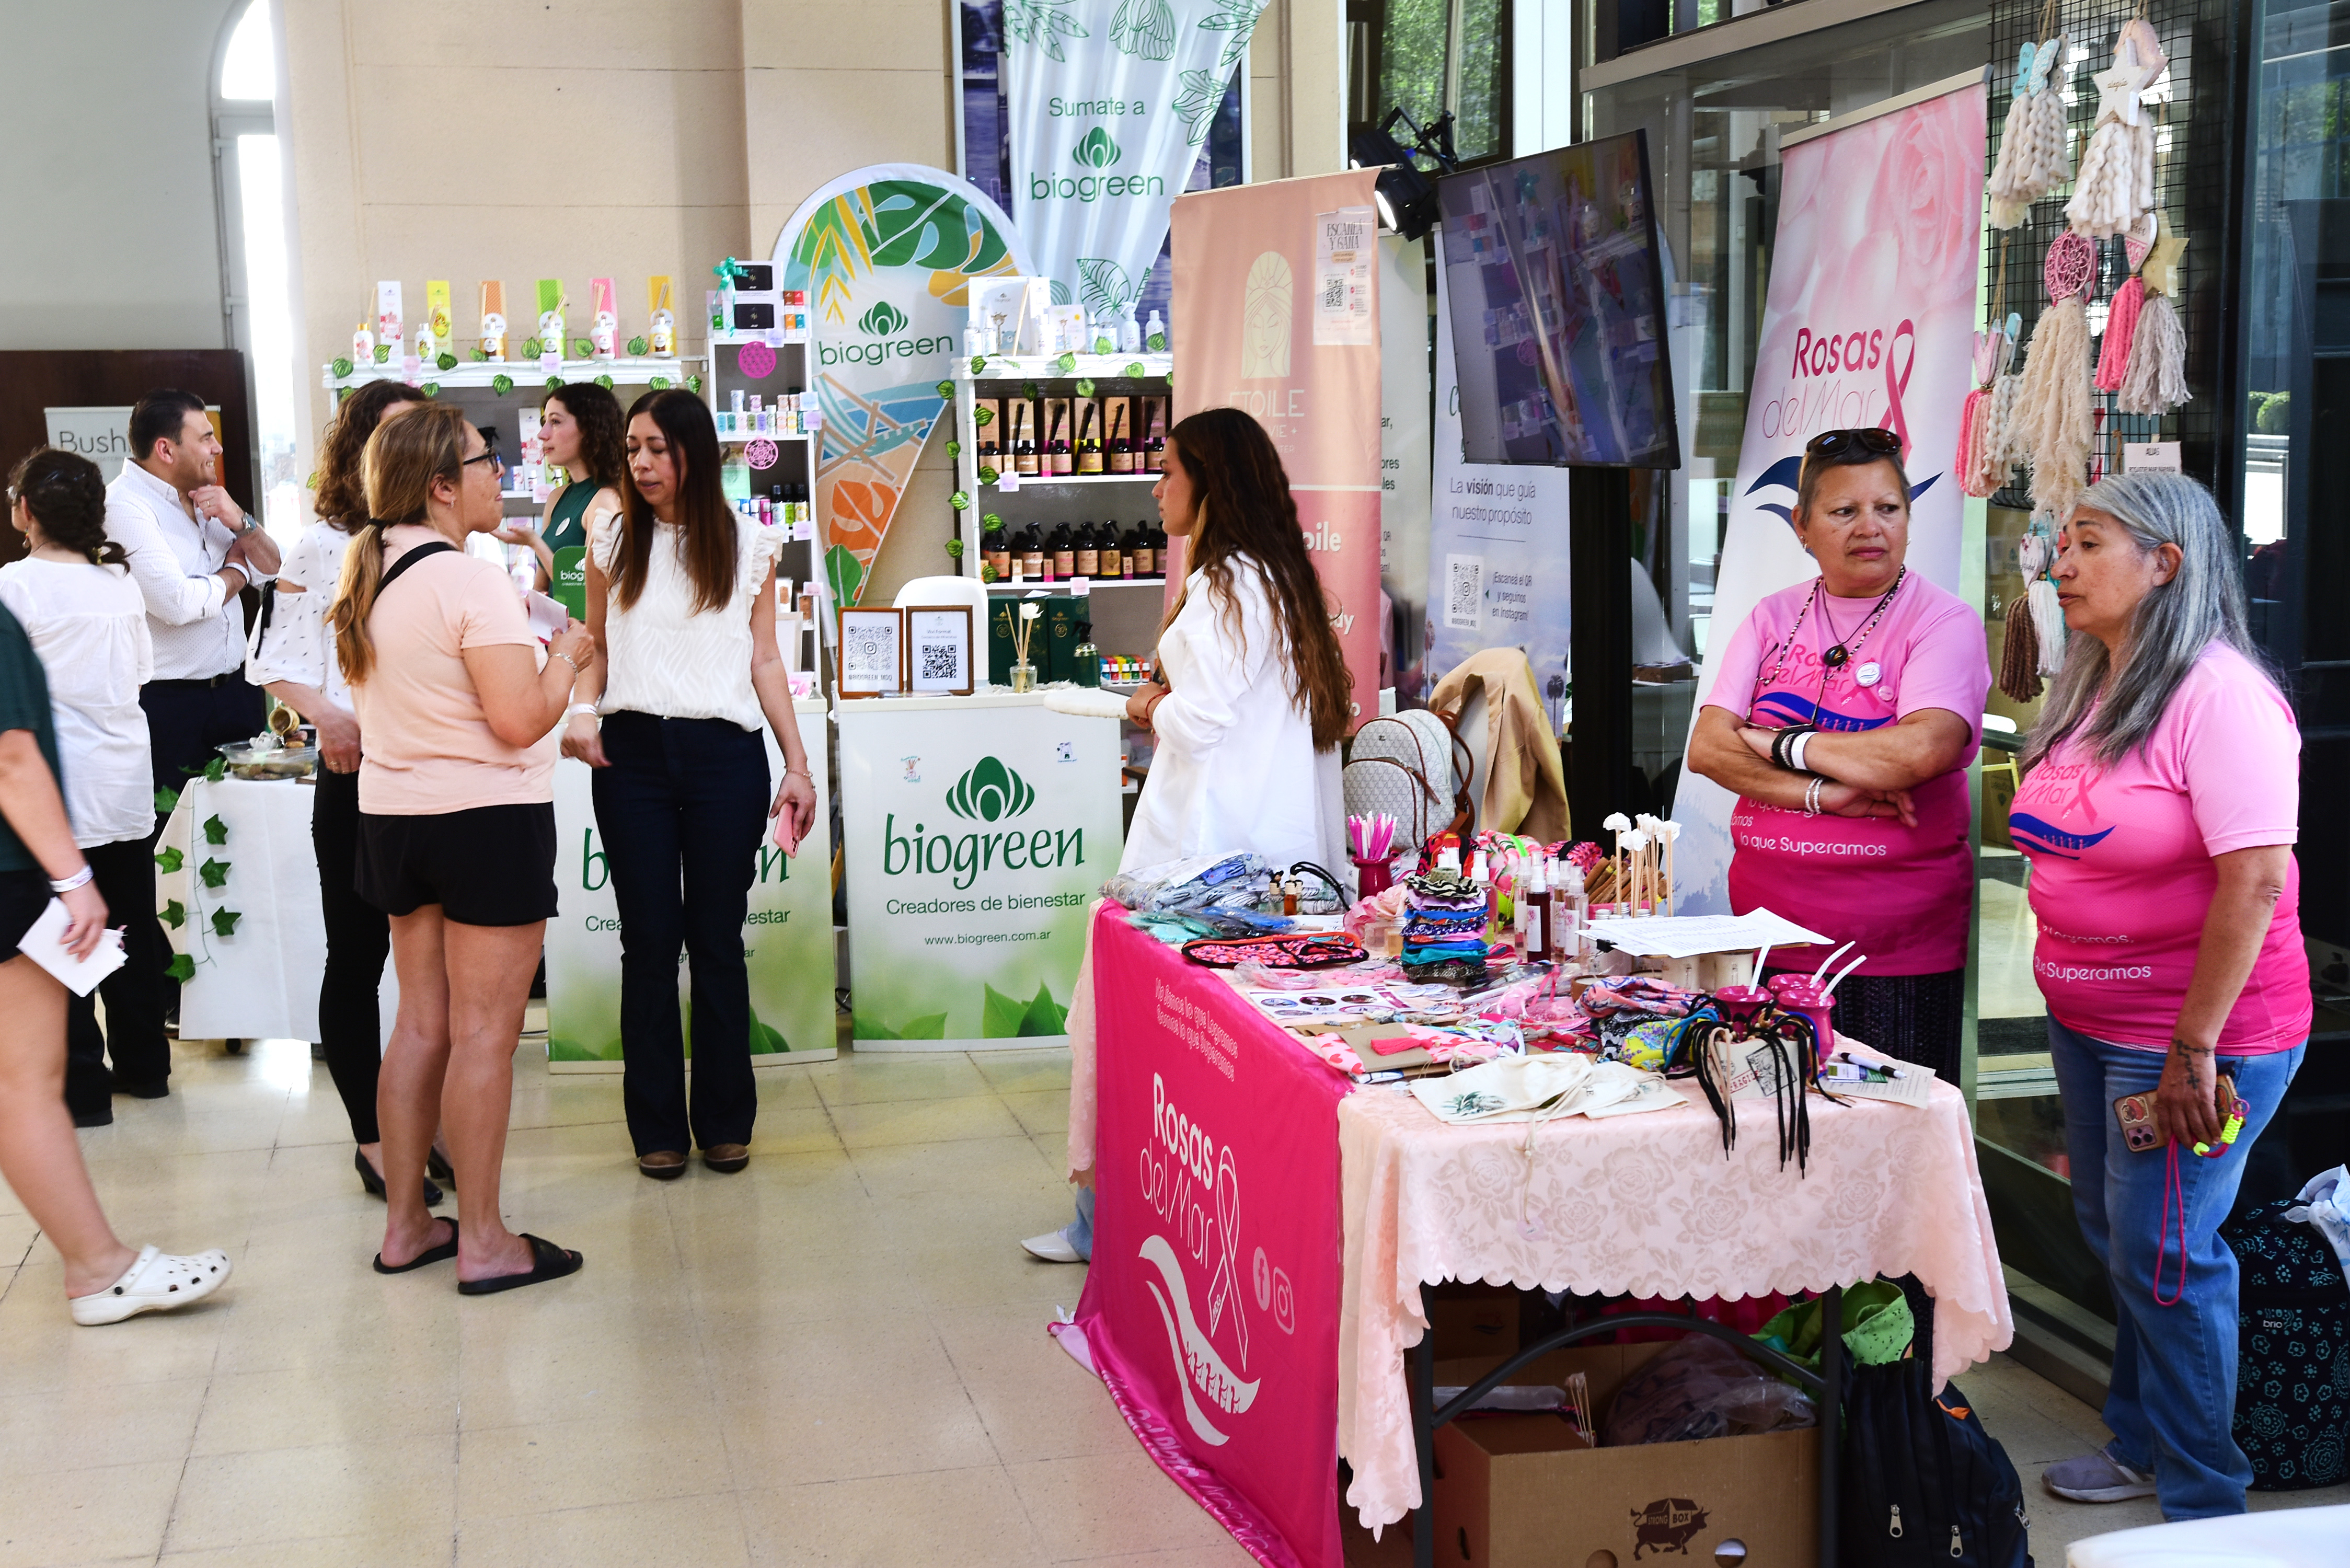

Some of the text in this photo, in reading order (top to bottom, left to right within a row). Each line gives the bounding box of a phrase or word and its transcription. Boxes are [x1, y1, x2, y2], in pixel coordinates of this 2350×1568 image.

[1049, 97, 1145, 117] Sumate a
[1031, 172, 1164, 202] biogreen
[819, 334, 953, 365] biogreen
[1792, 328, 1883, 379] Rosas
[1450, 477, 1536, 501] La visión que guía
[1453, 505, 1532, 526] nuestro propósito
[1492, 607, 1500, 617] en
[884, 813, 1085, 890] biogreen
[1740, 831, 1886, 856] lo que Superamos
[886, 892, 1086, 915] Creadores de bienestar
[925, 930, 1052, 946] www.biogreen.com.ar
[2047, 962, 2152, 983] Superamos
[1164, 984, 1185, 1015] Somos
[1184, 996, 1193, 1019] lo
[1194, 1006, 1207, 1029] que
[1207, 1010, 1238, 1059] Logramos
[1157, 1004, 1235, 1082] Somos lo que Superamos
[1154, 1072, 1213, 1190] Rosas
[2263, 1320, 2283, 1328] brio
[1648, 1513, 1689, 1525] STRONG BOX
